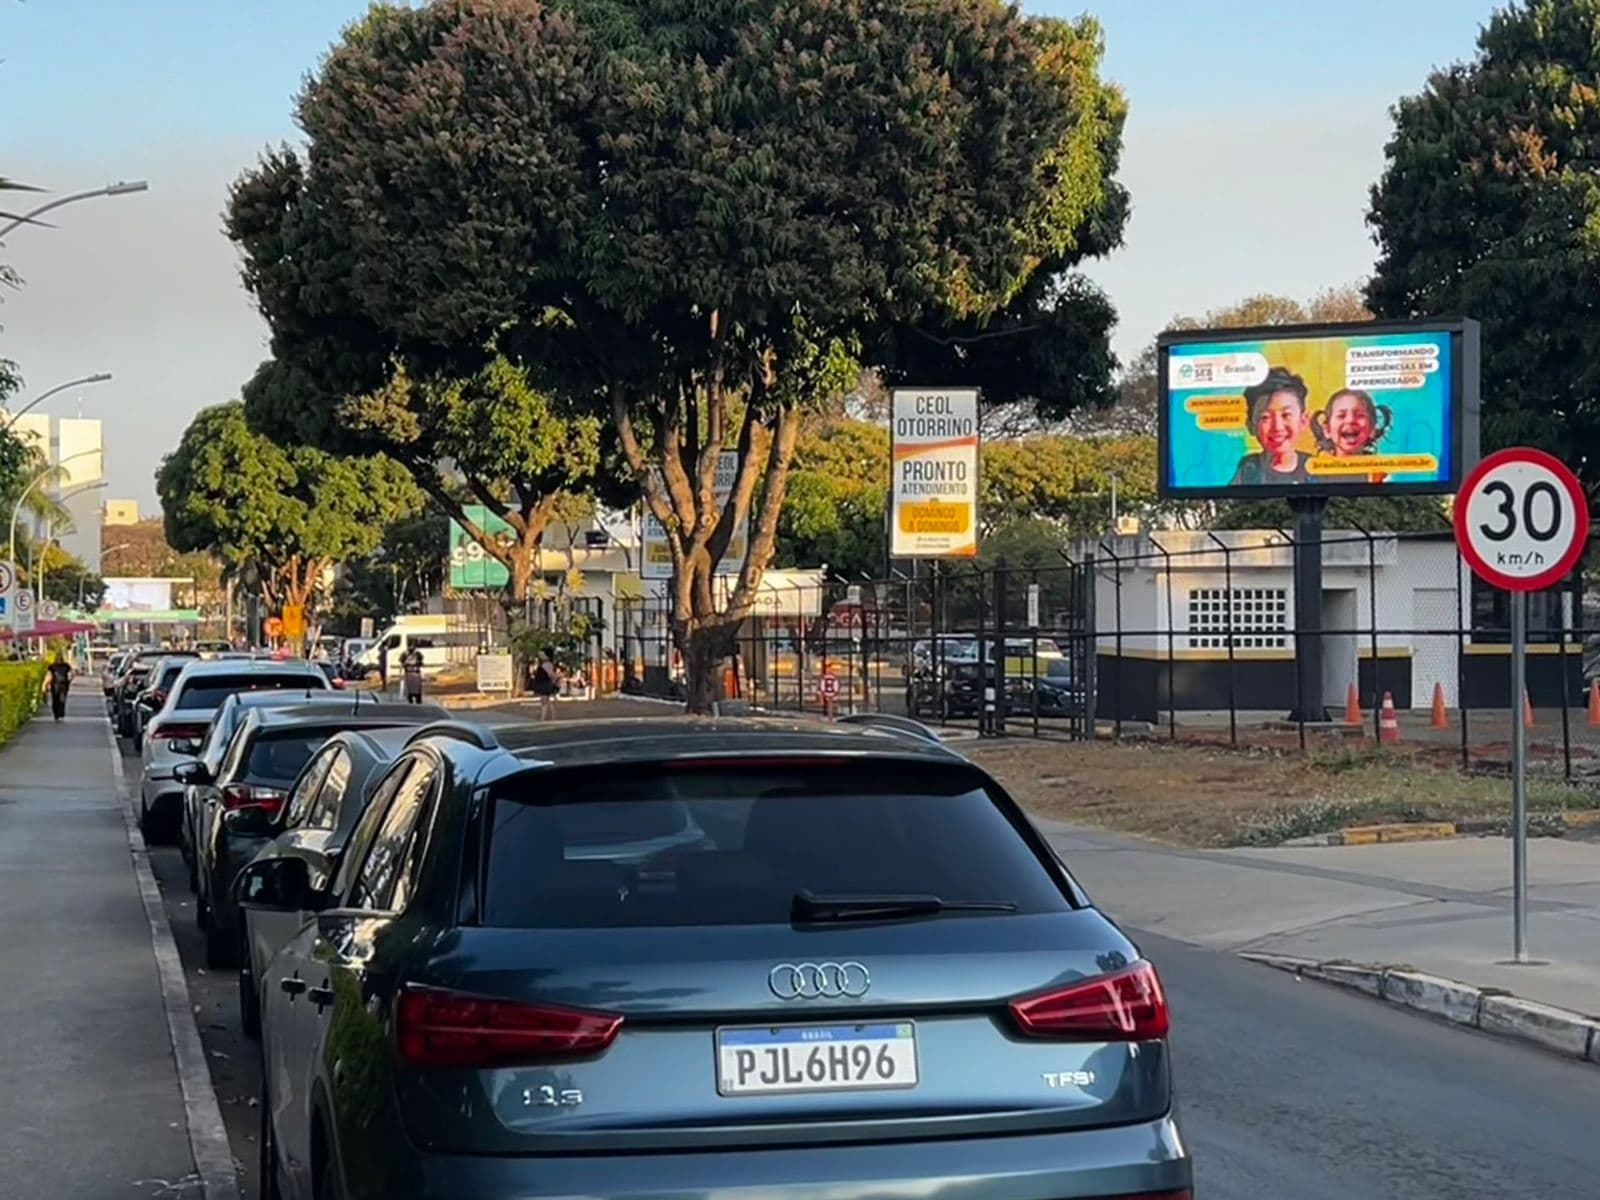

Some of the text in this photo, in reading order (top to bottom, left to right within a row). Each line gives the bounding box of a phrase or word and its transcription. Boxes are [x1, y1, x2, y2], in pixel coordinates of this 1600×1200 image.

[1350, 347, 1435, 358] TRANSFORMANDO
[1350, 361, 1415, 373] EXPERIÊNCIAS
[916, 396, 953, 415] CEOL
[897, 418, 972, 437] OTORRINO
[902, 461, 966, 481] PRONTO
[901, 483, 967, 495] ATENDIMENTO
[1480, 480, 1562, 542] 30
[1497, 552, 1544, 565] km/h
[736, 1043, 896, 1086] PJL6H96
